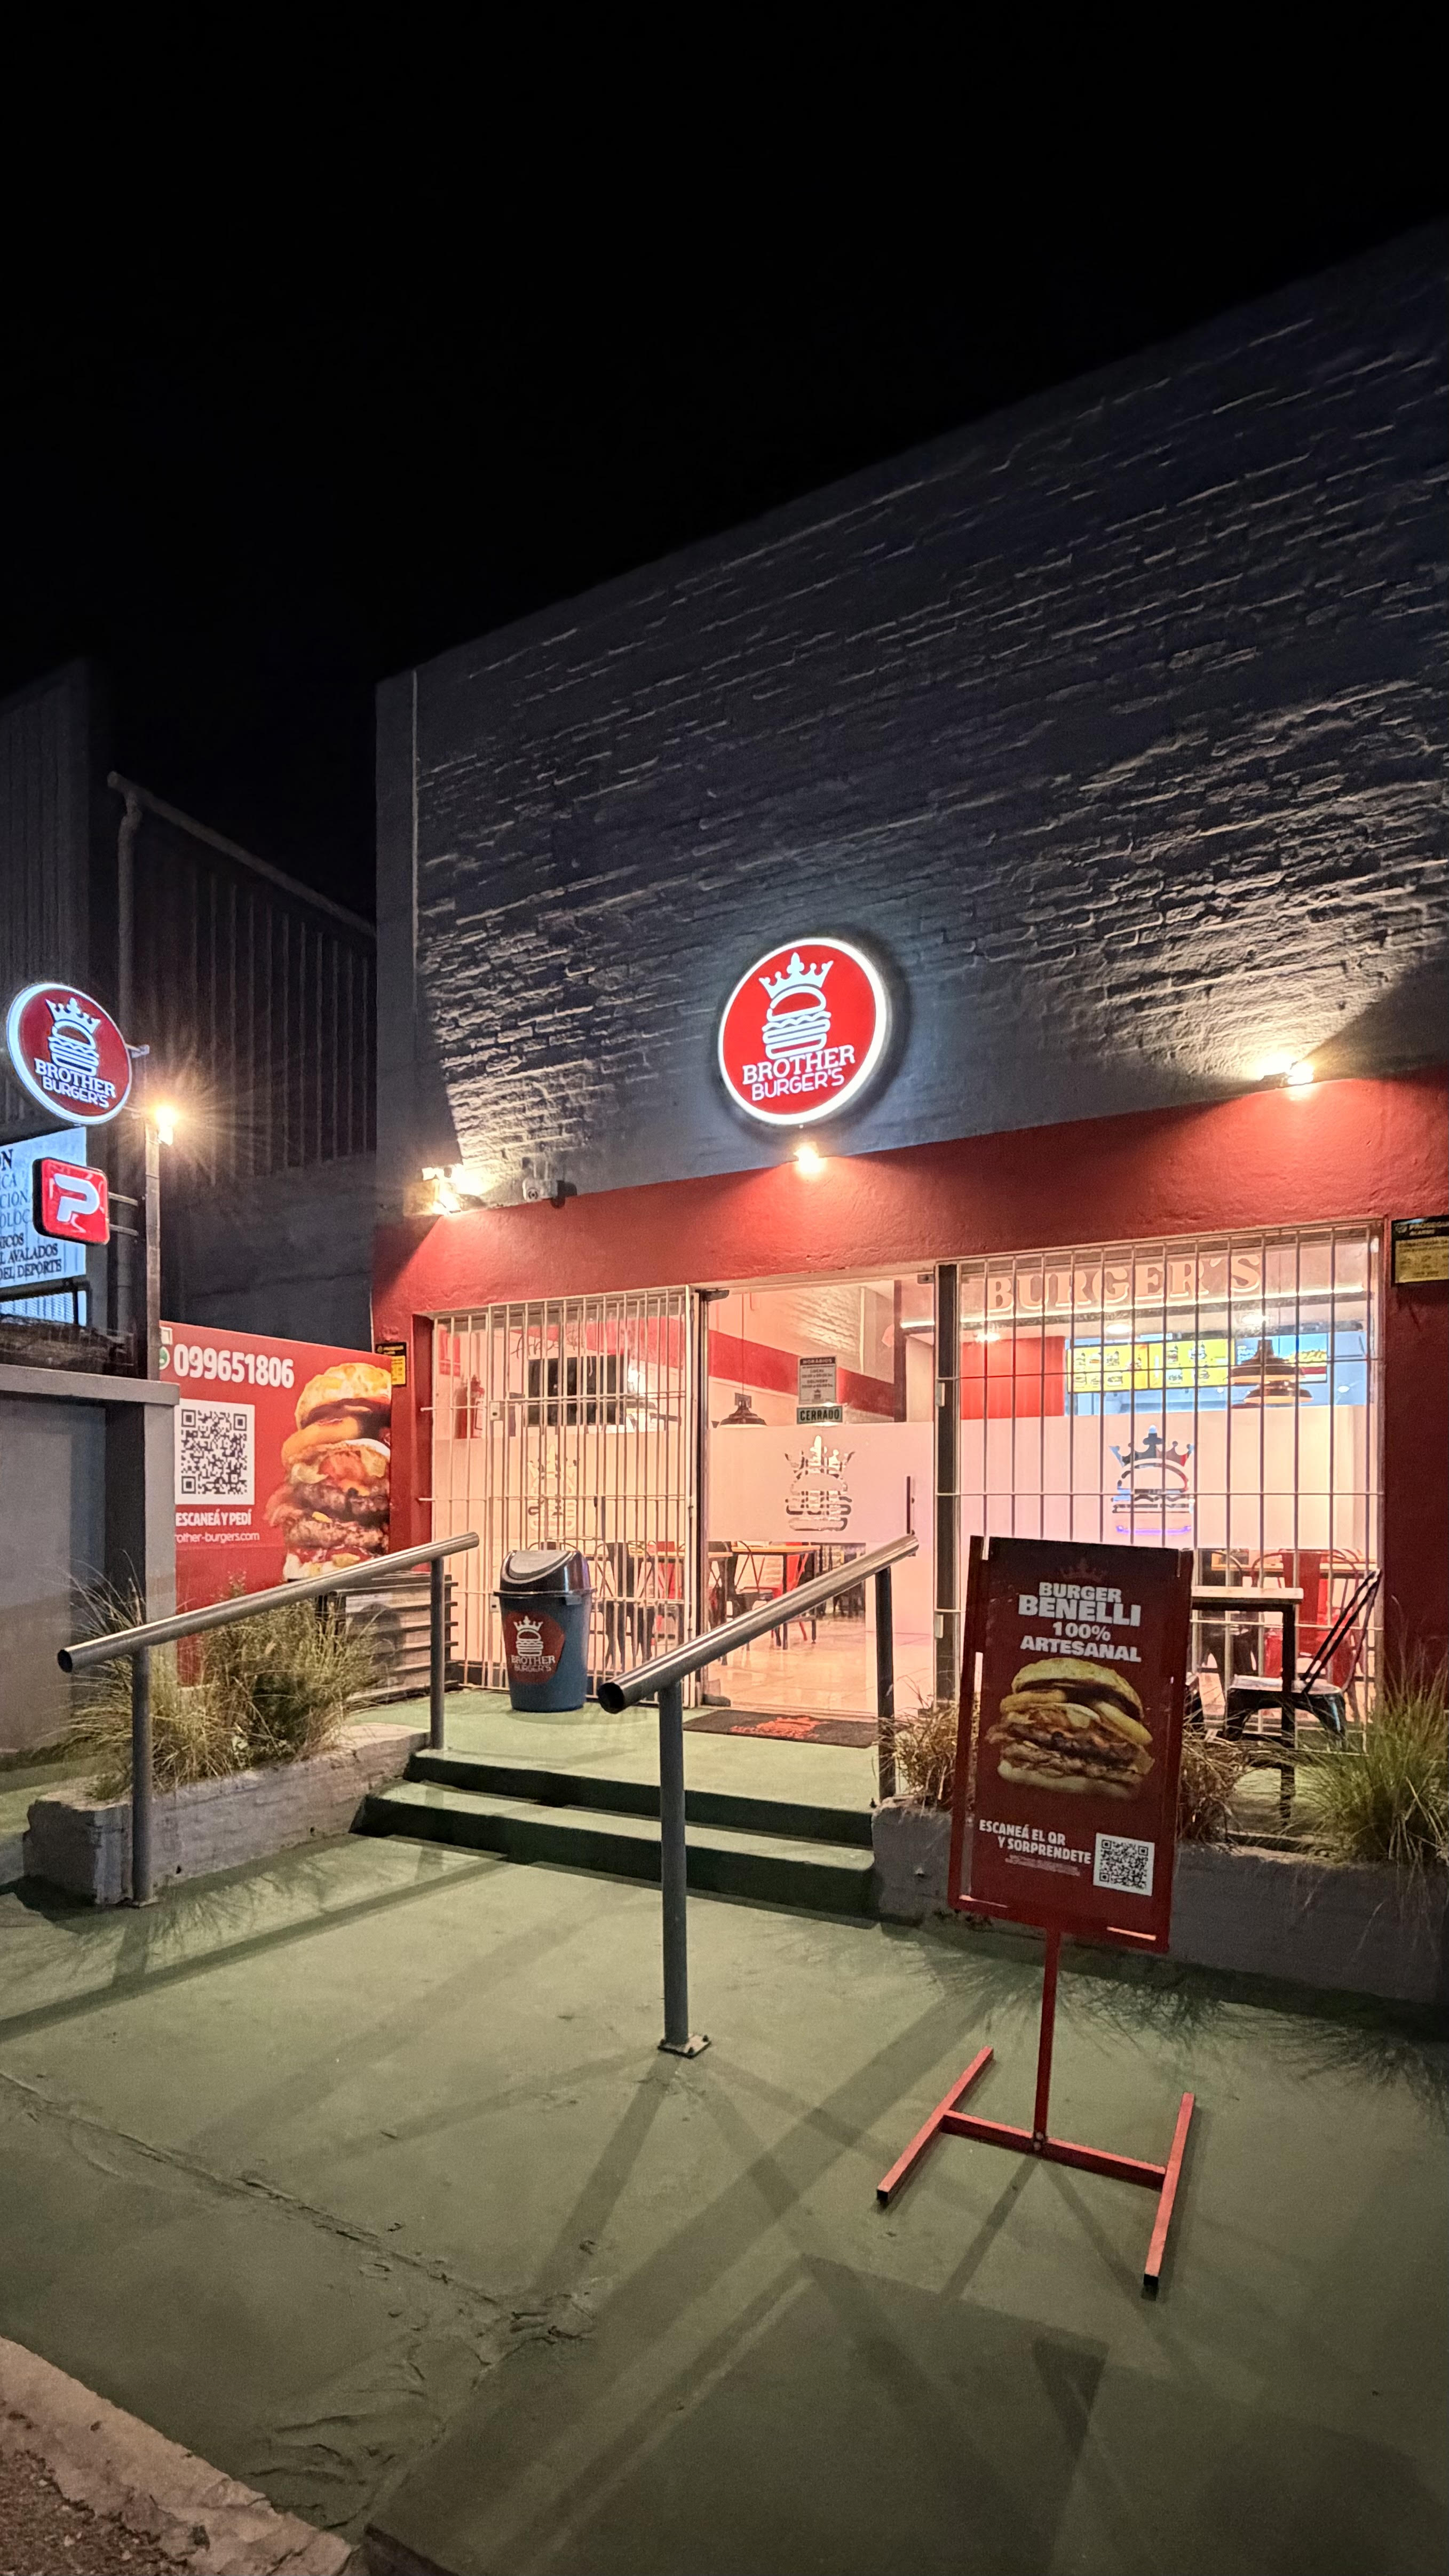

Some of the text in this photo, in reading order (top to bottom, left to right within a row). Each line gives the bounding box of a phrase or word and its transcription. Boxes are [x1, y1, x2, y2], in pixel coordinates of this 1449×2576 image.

[34, 1058, 116, 1098] BROTHER
[742, 1044, 856, 1085] BROTHER
[43, 1076, 109, 1108] BURGER'S
[751, 1068, 845, 1101] BURGER'S
[8, 1243, 58, 1264] AVALADOS
[17, 1258, 61, 1278] DEPORTE
[987, 1254, 1261, 1312] BURGER'S
[173, 1344, 295, 1388] 099651806
[800, 1409, 840, 1421] CERRADO
[175, 1508, 252, 1526] ESCANEÁ Y PEDÍ
[1039, 1582, 1121, 1603] BURGER
[1018, 1594, 1141, 1627] BENELLI
[1052, 1622, 1111, 1642] 100%
[511, 1655, 556, 1665] BROTHER
[1020, 1635, 1142, 1662] ARTESANAL
[979, 1819, 1066, 1845] ESCANEÁ EL QR
[997, 1836, 1091, 1864] Y SORPRENDETE
